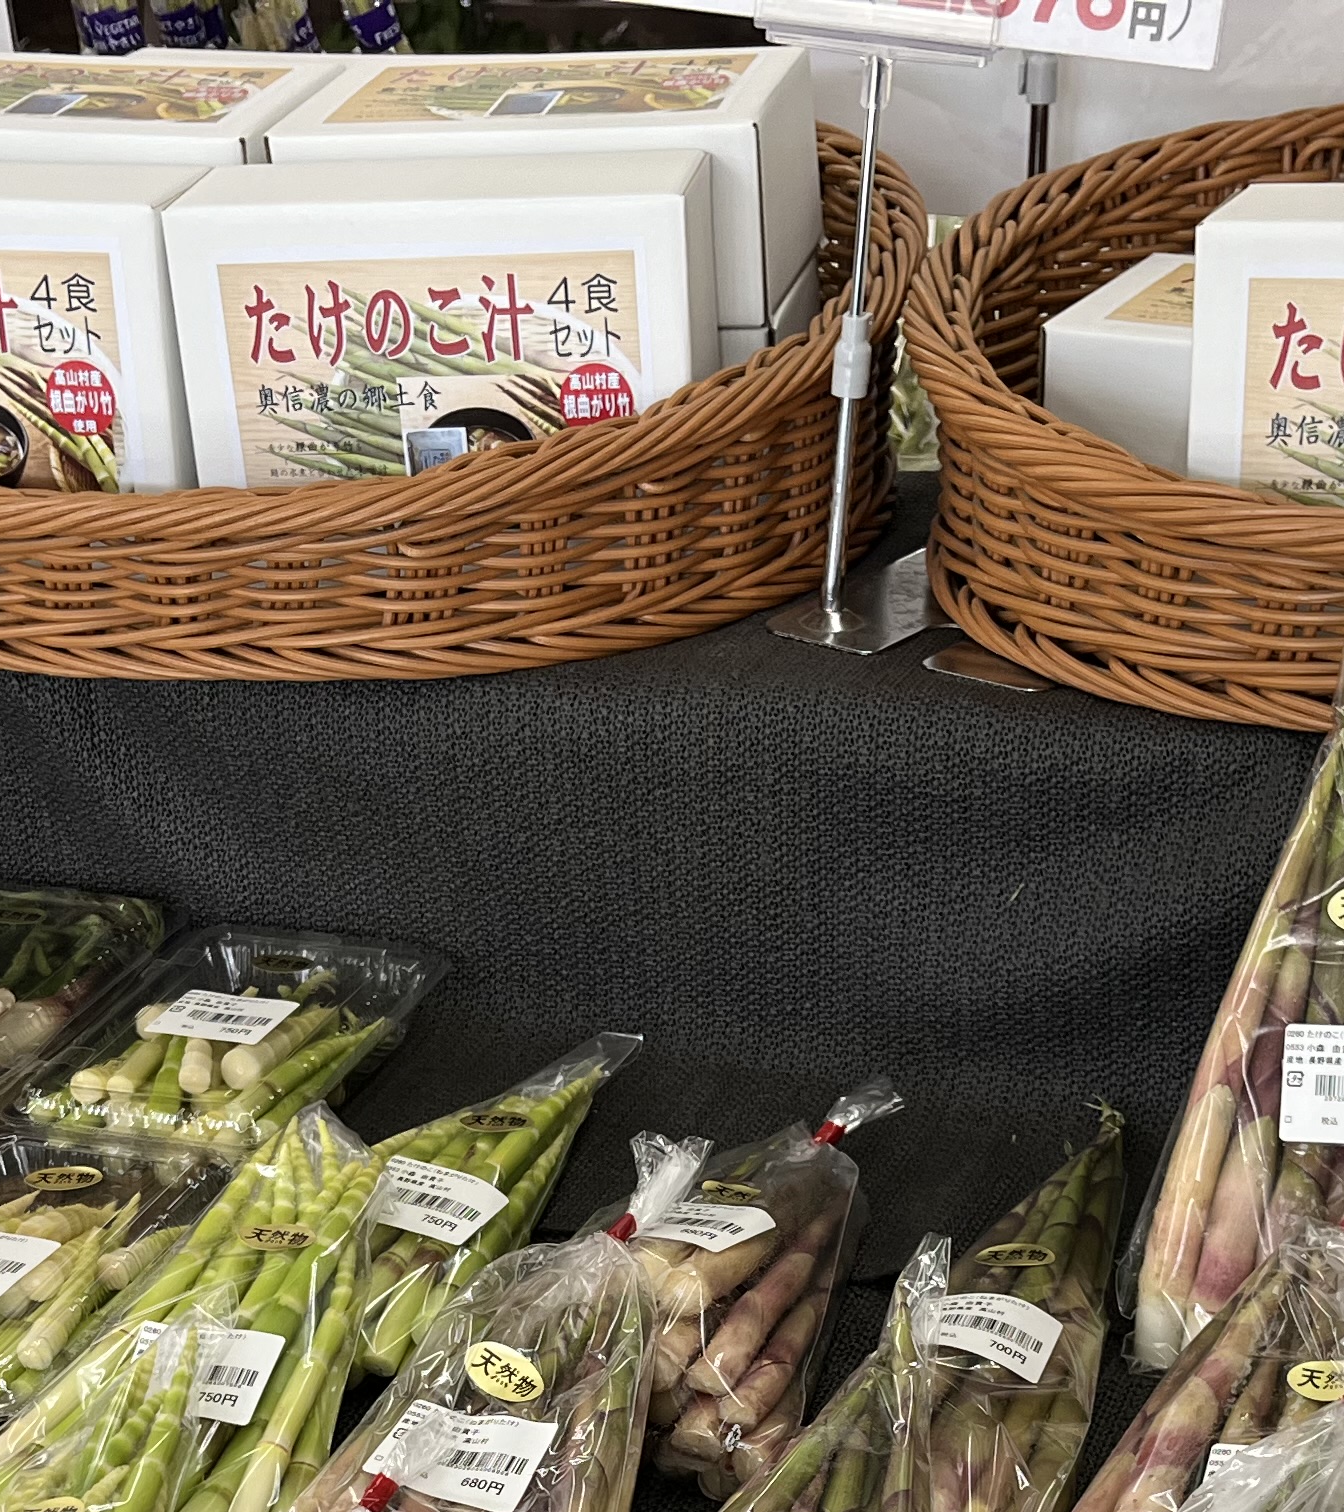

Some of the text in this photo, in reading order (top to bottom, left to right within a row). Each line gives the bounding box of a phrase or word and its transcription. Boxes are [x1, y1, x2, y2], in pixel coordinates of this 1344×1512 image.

[30, 273, 98, 313] 4食
[244, 273, 619, 366] たけのこ汁 4食
[33, 315, 101, 356] セット
[549, 317, 622, 358] セット
[53, 369, 103, 388] 高山村産
[569, 372, 622, 390] 高山村産
[49, 388, 113, 415] 根曲がり竹
[257, 381, 442, 414] 奥信濃の郷土食
[562, 393, 633, 420] 根曲がり竹
[71, 419, 98, 433] 使用
[34, 1173, 96, 1184] 天然物
[420, 1213, 458, 1233] 750円
[244, 1226, 310, 1248] 天然物
[988, 1338, 1028, 1364] 700円
[471, 1347, 538, 1398] 天然物
[197, 1390, 239, 1408] 750円
[460, 1477, 505, 1496] 680円
